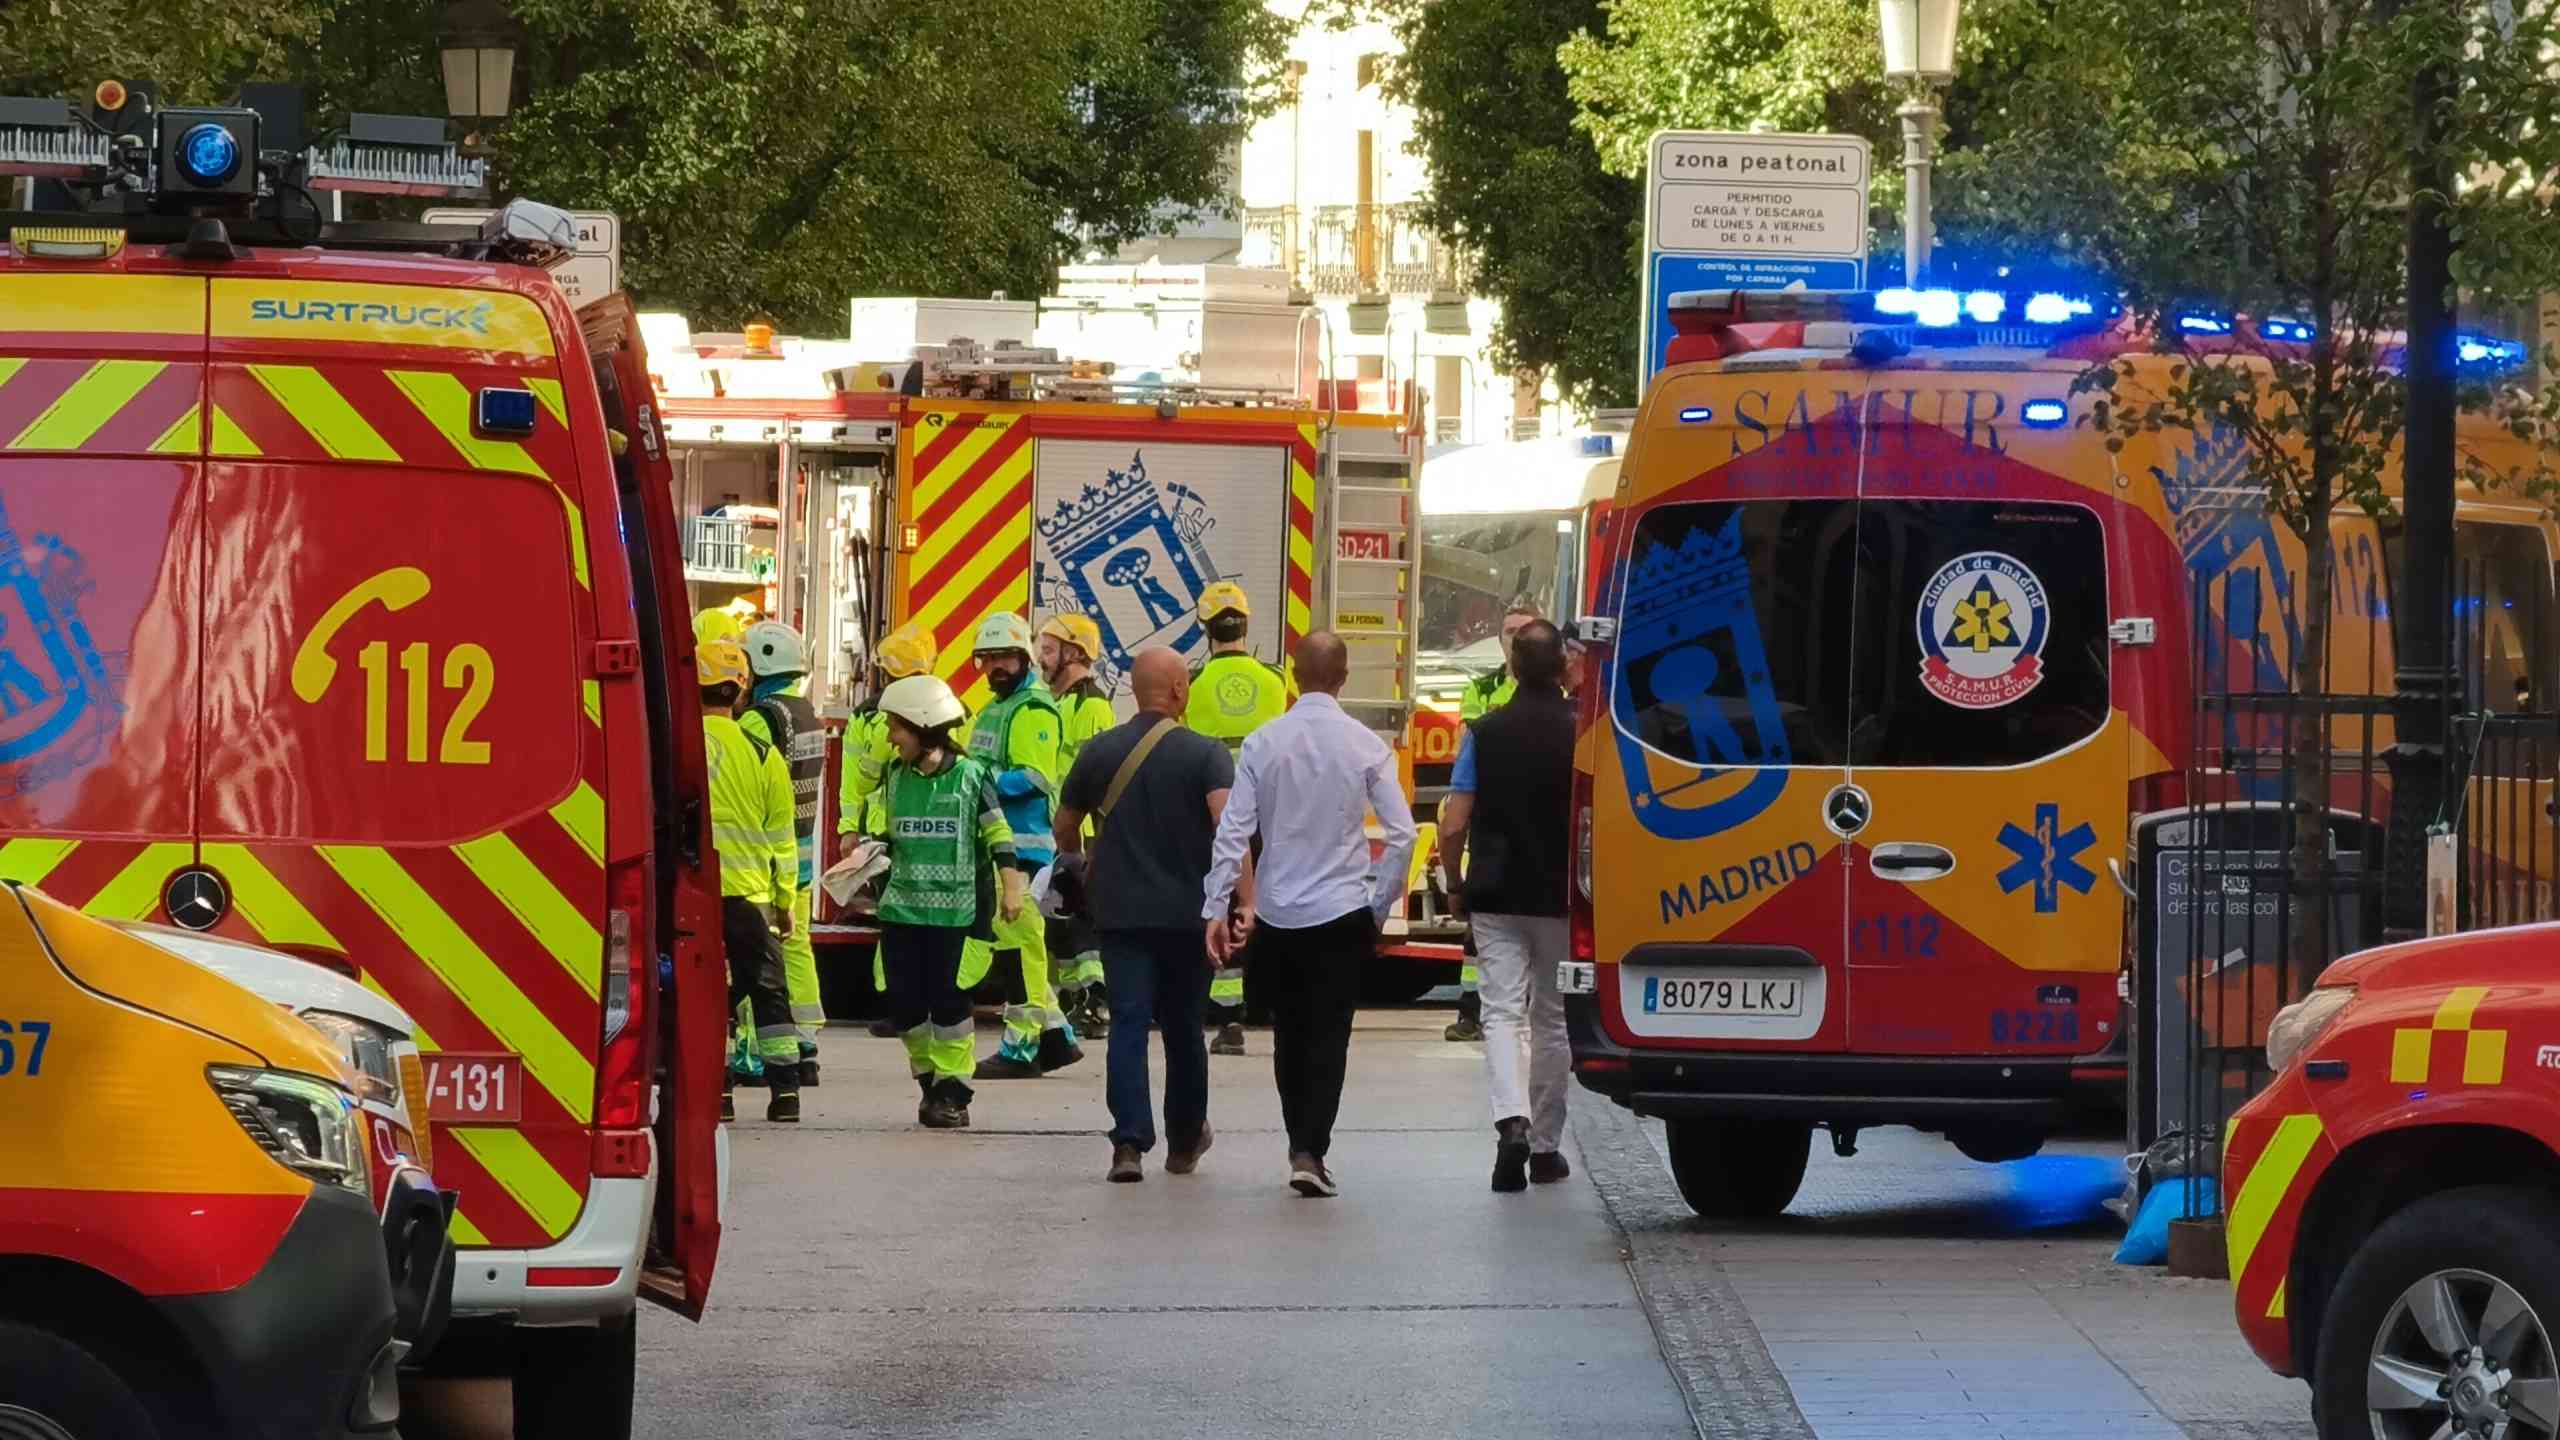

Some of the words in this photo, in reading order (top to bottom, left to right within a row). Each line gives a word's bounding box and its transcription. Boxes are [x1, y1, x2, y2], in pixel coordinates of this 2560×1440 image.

[1675, 154, 1728, 168] zona
[1741, 154, 1846, 173] peatonal
[1727, 192, 1792, 204] PERMITIDO
[1694, 205, 1737, 216] CARGA
[1743, 206, 1750, 216] Y
[1755, 207, 1824, 219] DESCARGA
[1691, 218, 1707, 229] DE
[1713, 219, 1753, 230] LUNES
[1759, 220, 1768, 231] A
[1773, 221, 1825, 232] VIERNES
[1721, 232, 1737, 243] DE
[1756, 234, 1765, 244] A
[250, 299, 467, 329] SURTRUCK
[1731, 388, 2007, 459] SAMUR
[1926, 561, 1966, 609] ciudad
[1973, 556, 1992, 570] de
[1998, 561, 2044, 609] madrid
[2004, 676, 2034, 698] CIVIL
[359, 640, 495, 765] 112
[1659, 841, 1818, 925] MADRID
[1662, 981, 1733, 1009] 8079
[1742, 981, 1796, 1010] LKJ
